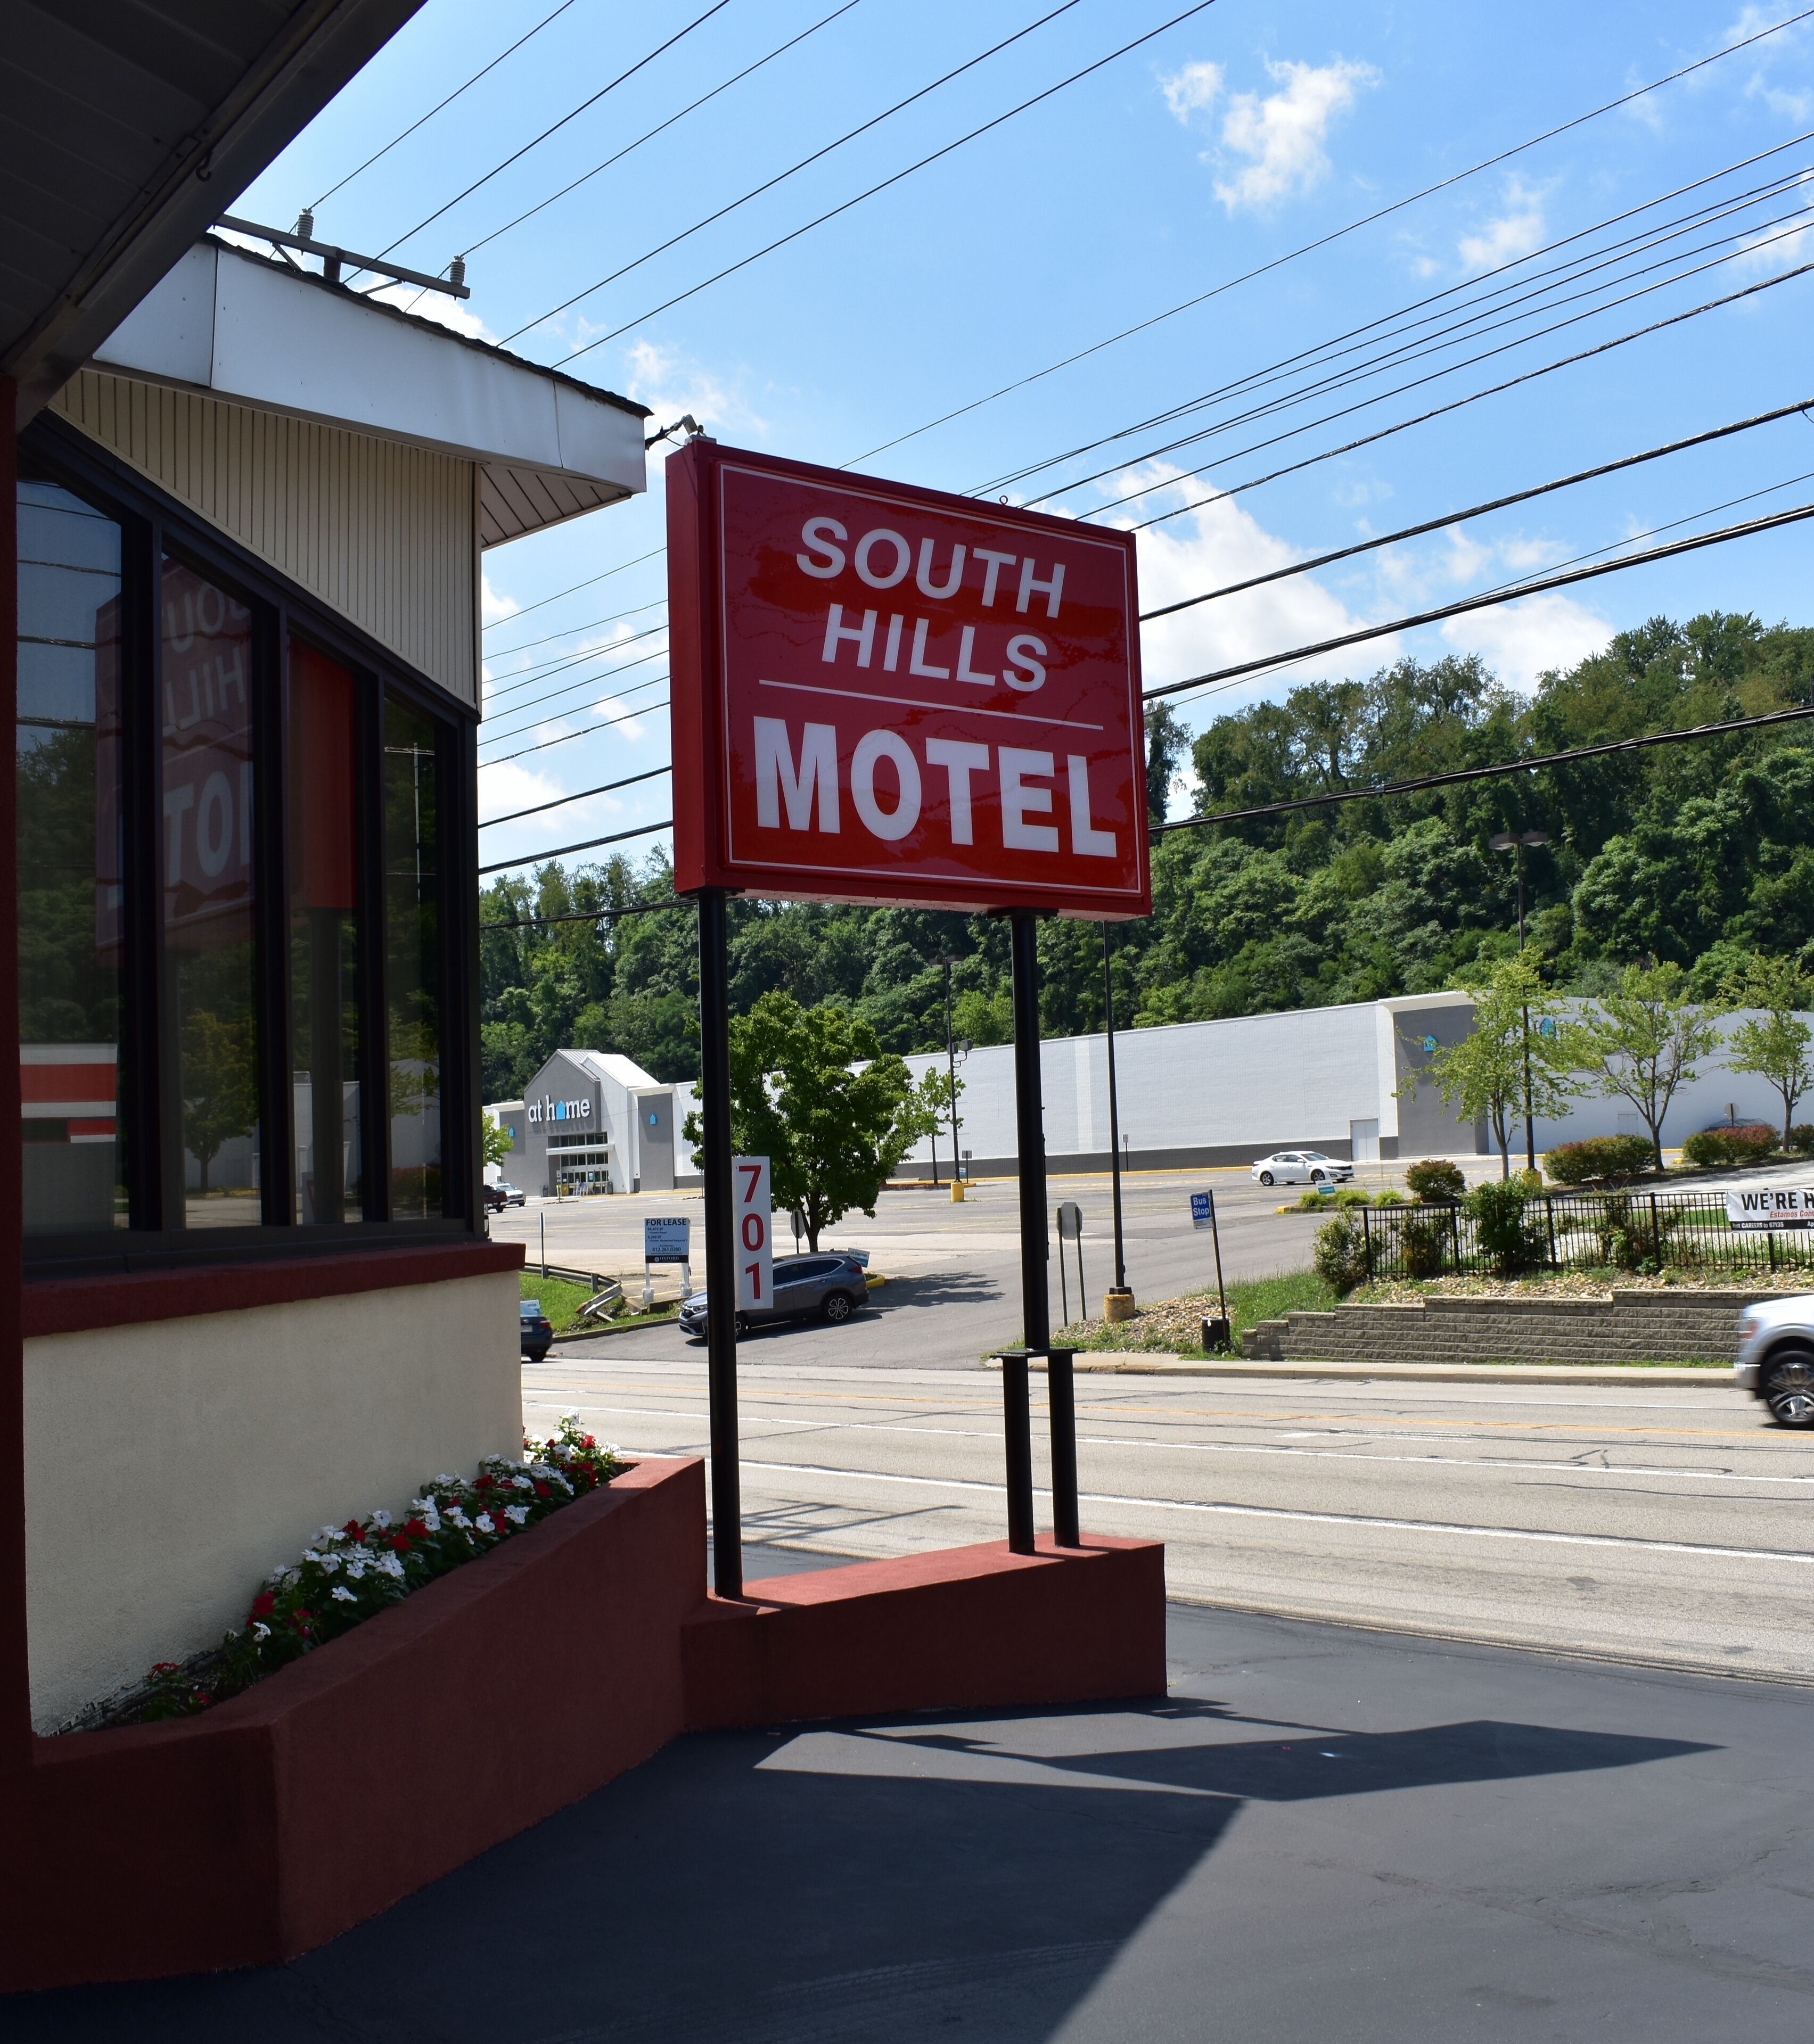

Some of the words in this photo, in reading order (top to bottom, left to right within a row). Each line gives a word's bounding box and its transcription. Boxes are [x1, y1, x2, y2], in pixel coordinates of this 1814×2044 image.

[796, 516, 1065, 618] SOUTH
[822, 604, 1047, 692] HILLS
[753, 716, 1117, 858] MOTEL
[528, 1099, 542, 1123] at
[1193, 1197, 1206, 1206] Bus
[1193, 1207, 1209, 1216] Stop
[1741, 1192, 1798, 1210] WE'RE
